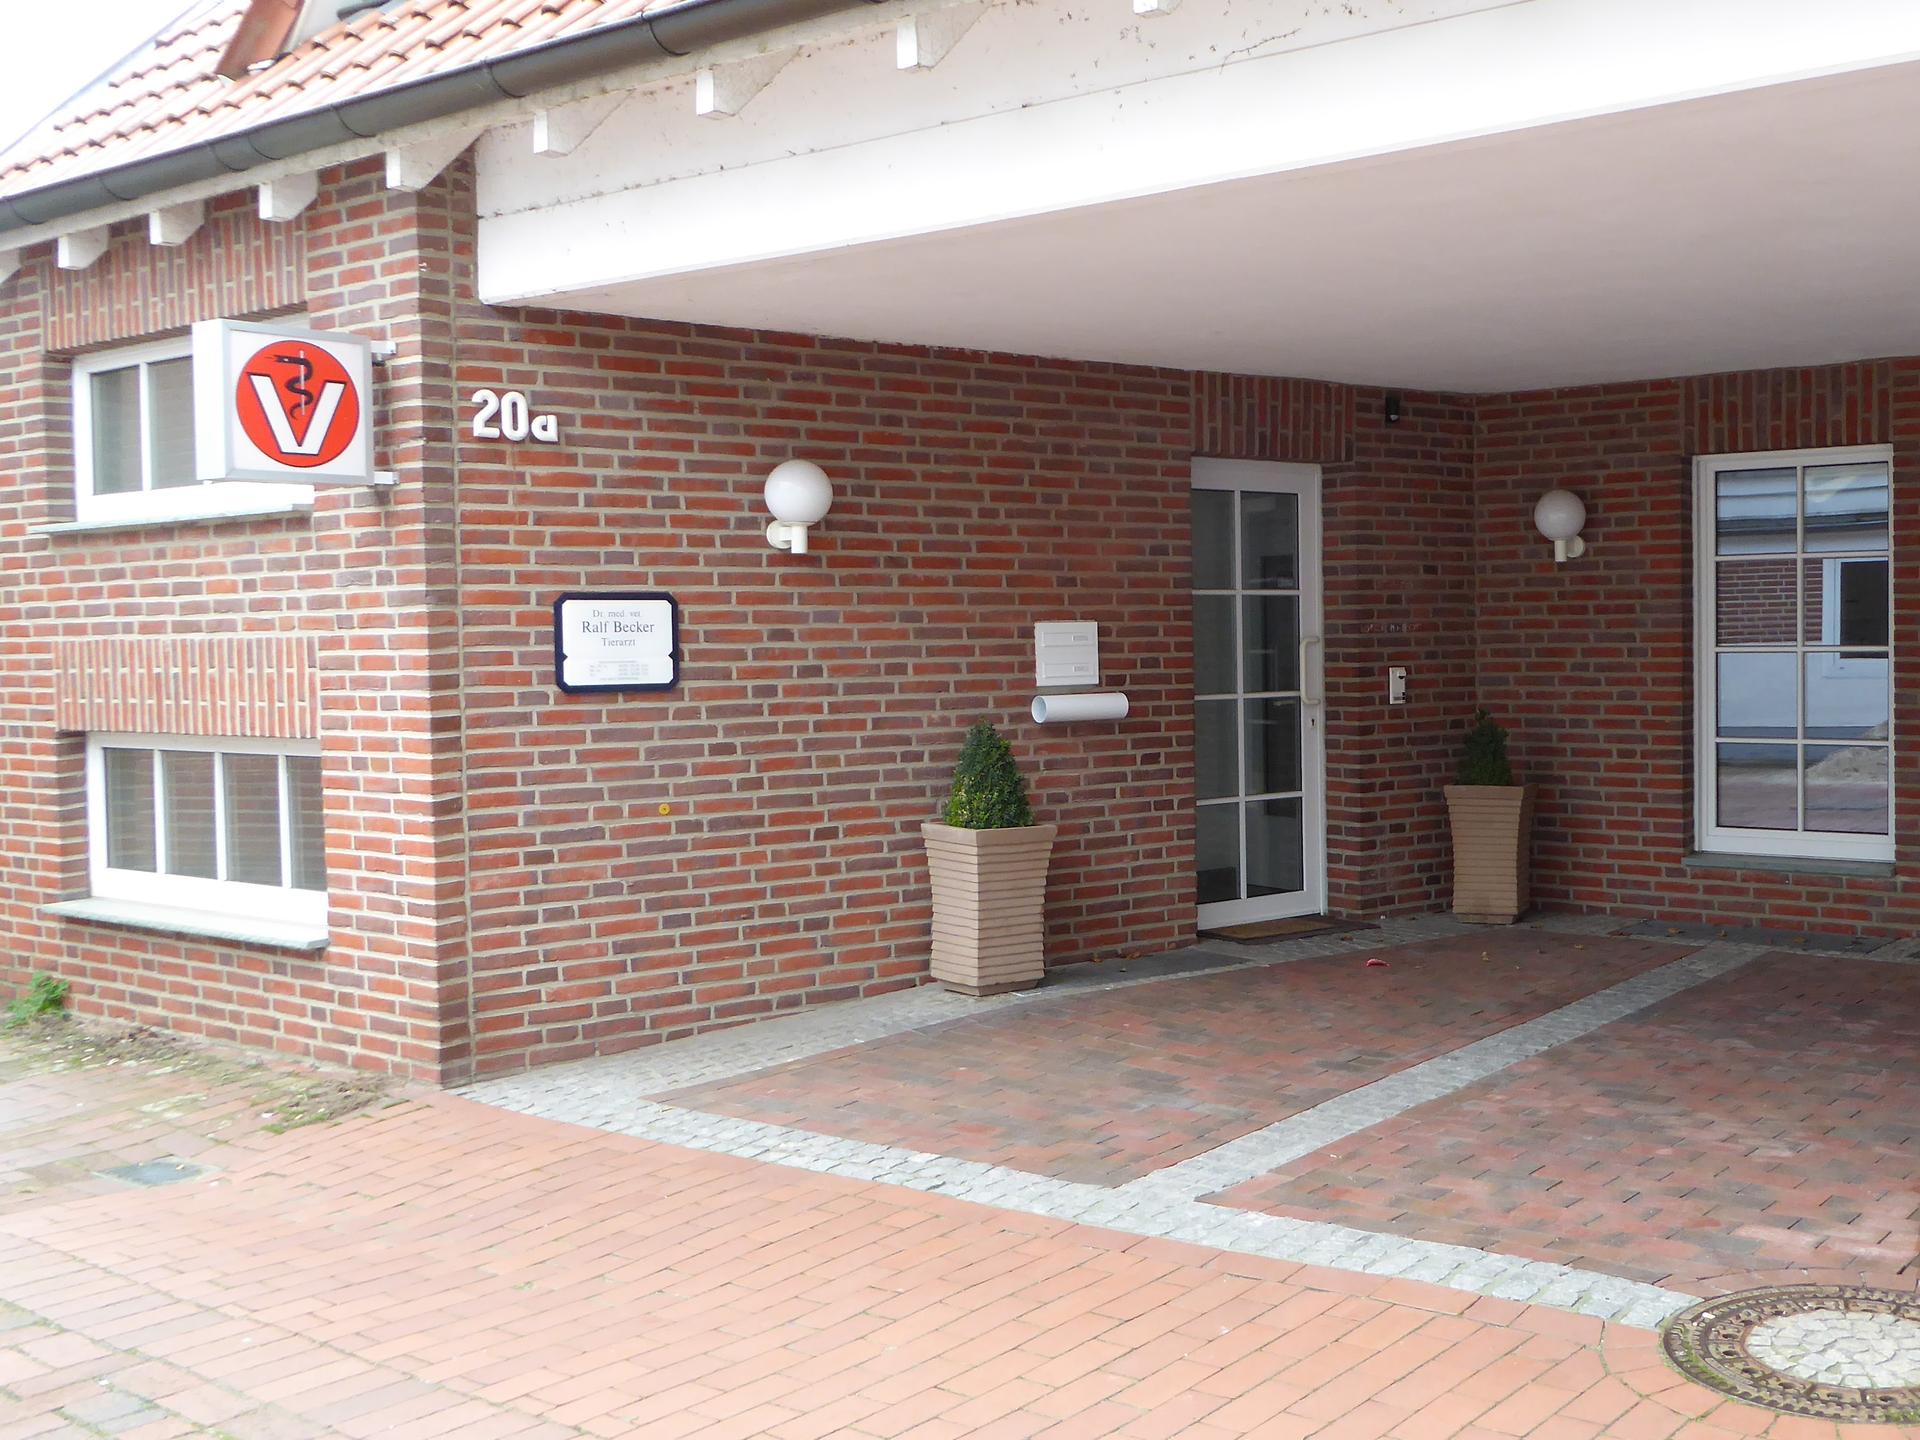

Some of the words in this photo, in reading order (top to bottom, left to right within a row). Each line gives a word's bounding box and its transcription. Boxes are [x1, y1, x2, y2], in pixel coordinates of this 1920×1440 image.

[247, 372, 347, 455] V
[471, 389, 559, 442] 20a
[582, 620, 608, 633] Ralf
[613, 620, 655, 633] Becker
[601, 637, 636, 647] Tierarzt
